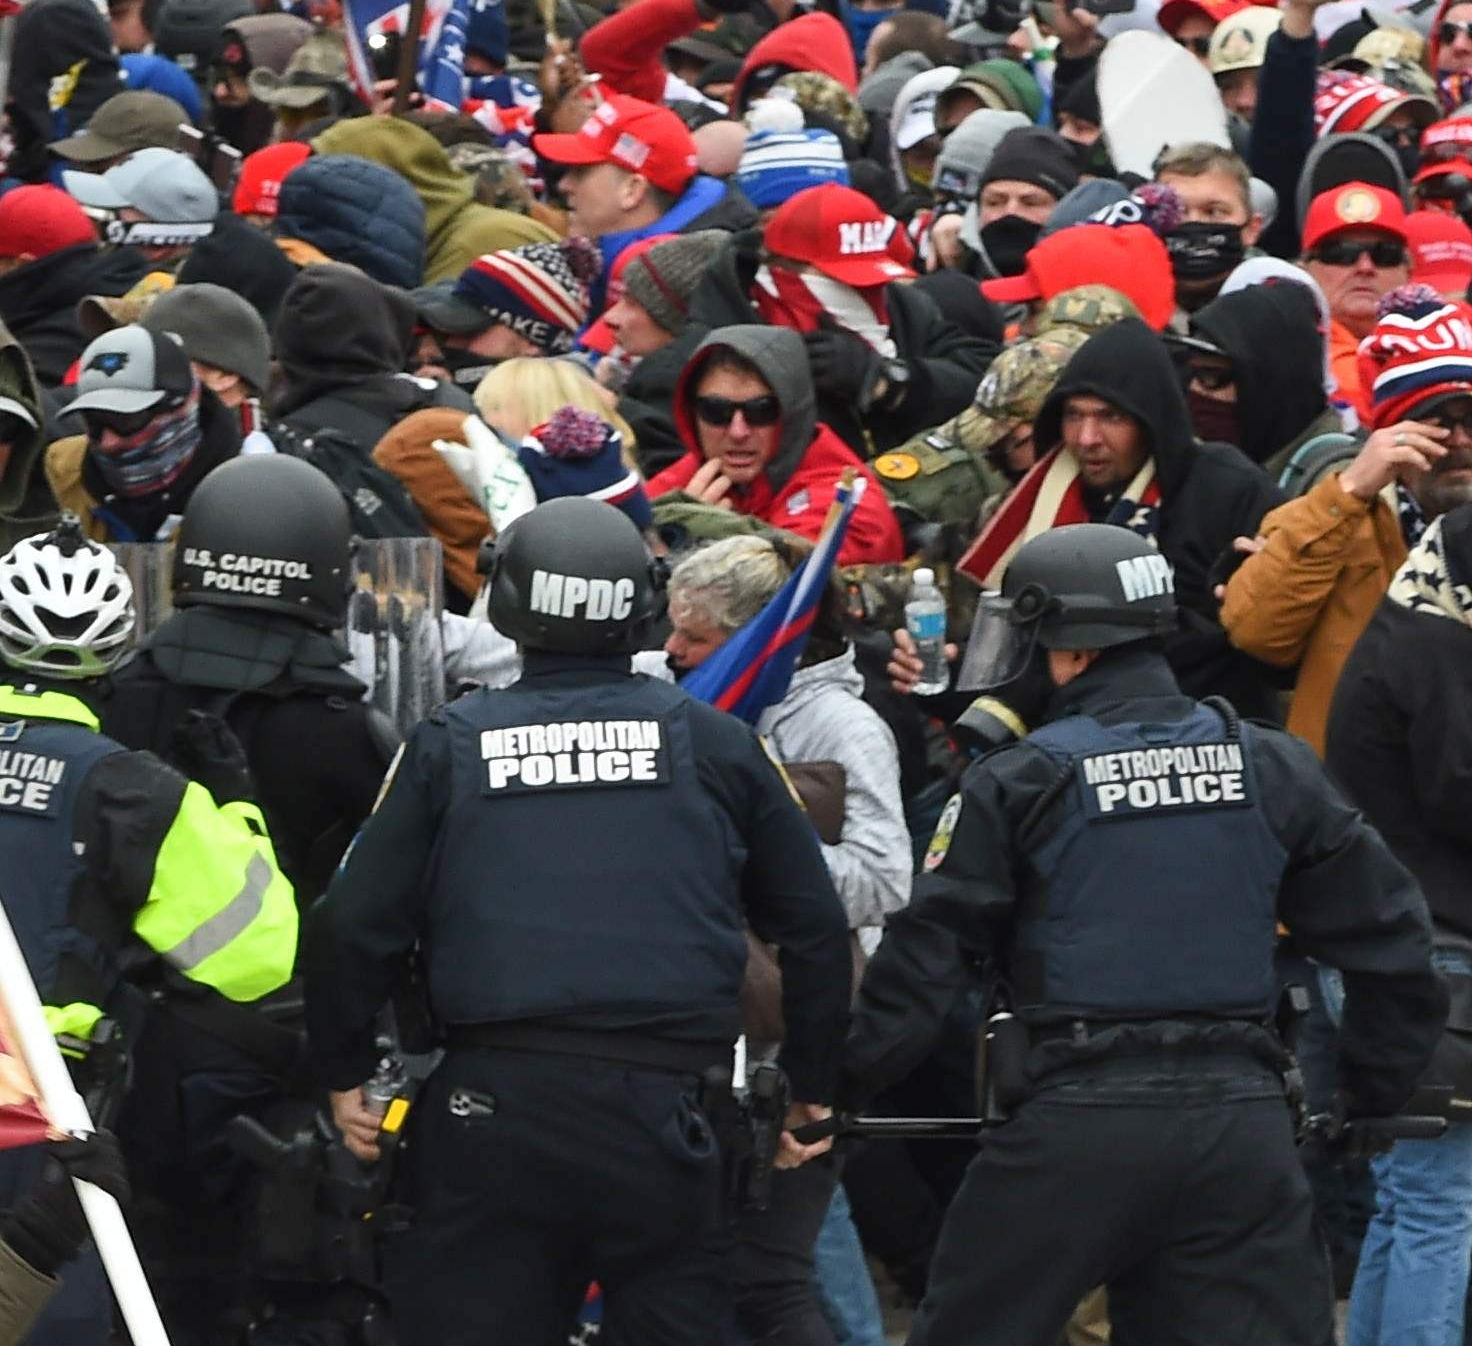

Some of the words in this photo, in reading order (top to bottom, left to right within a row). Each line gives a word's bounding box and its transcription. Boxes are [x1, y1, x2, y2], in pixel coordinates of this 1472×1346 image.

[183, 547, 217, 568] U.S.
[219, 552, 313, 581] CAPITOL
[201, 569, 283, 597] POLICE
[529, 568, 635, 621] MPDC
[480, 720, 661, 761] METROPOLITAN
[488, 750, 658, 790] POLICE
[1082, 743, 1245, 785] METROPOLITAN
[1095, 772, 1246, 813] POLICE
